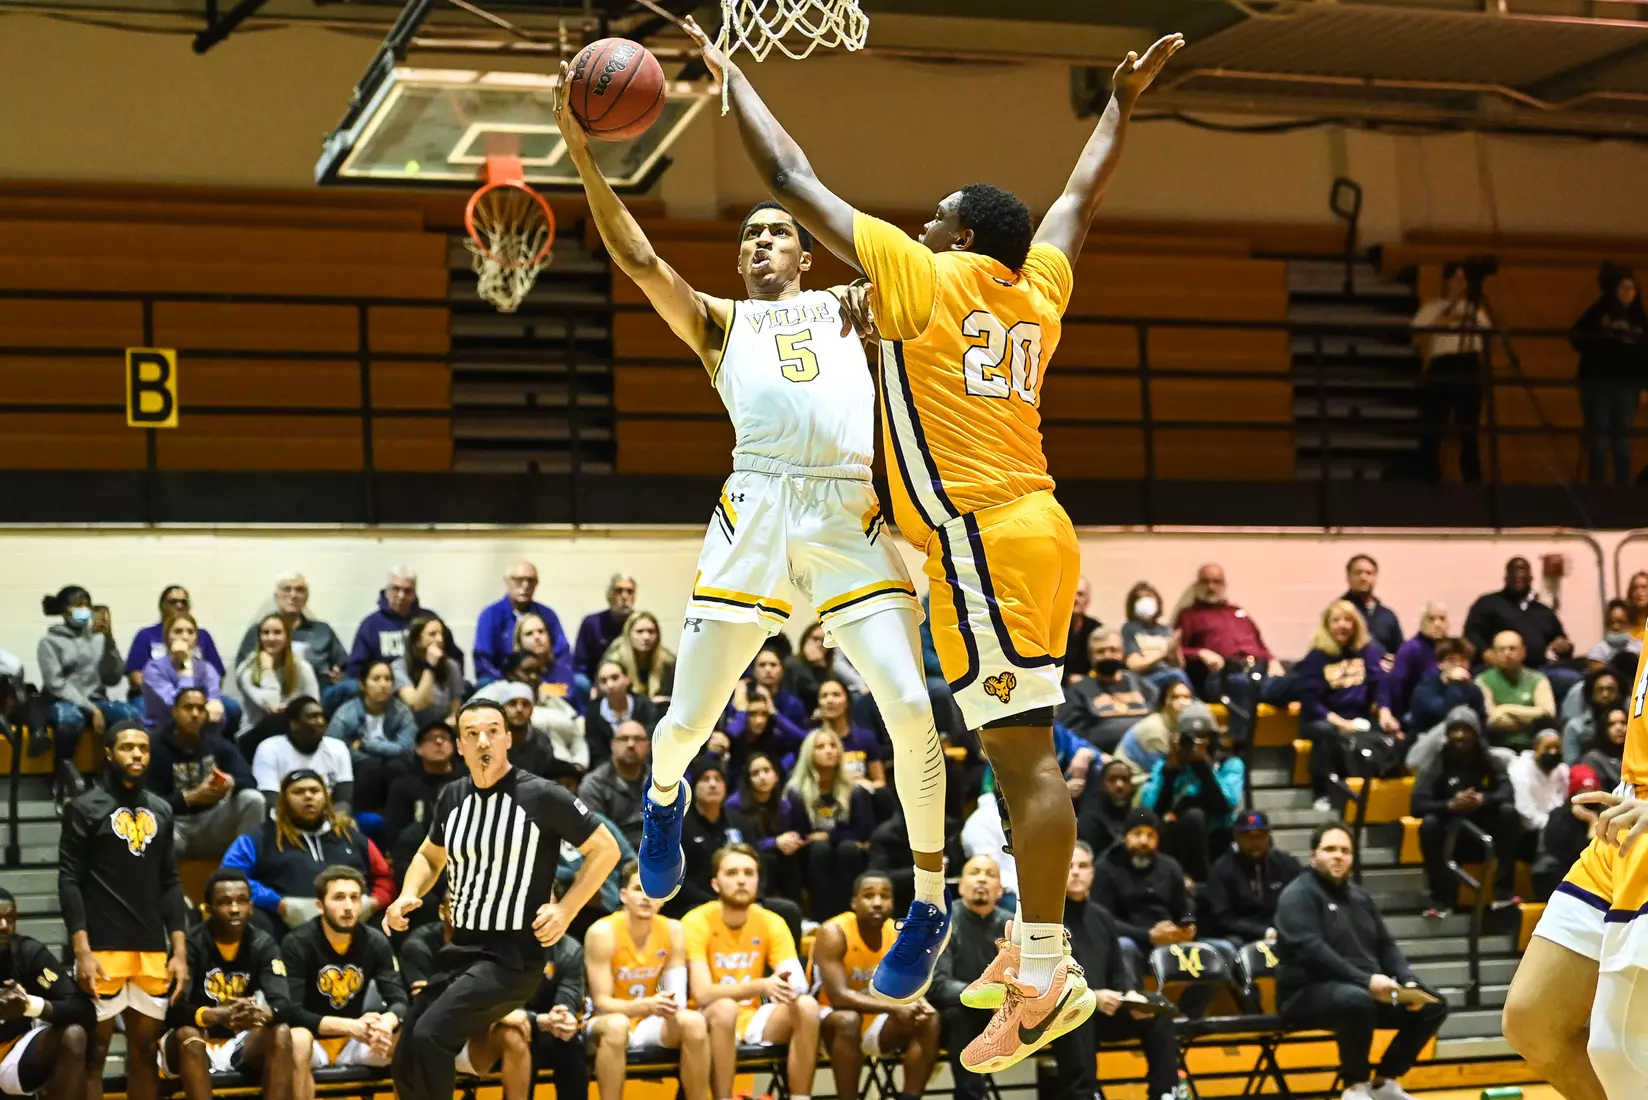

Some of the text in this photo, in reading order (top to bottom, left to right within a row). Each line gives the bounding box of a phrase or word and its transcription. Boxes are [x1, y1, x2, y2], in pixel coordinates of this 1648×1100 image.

[592, 43, 638, 96] Wilson
[774, 327, 820, 383] 5
[962, 309, 1042, 406] 20
[131, 352, 173, 421] B
